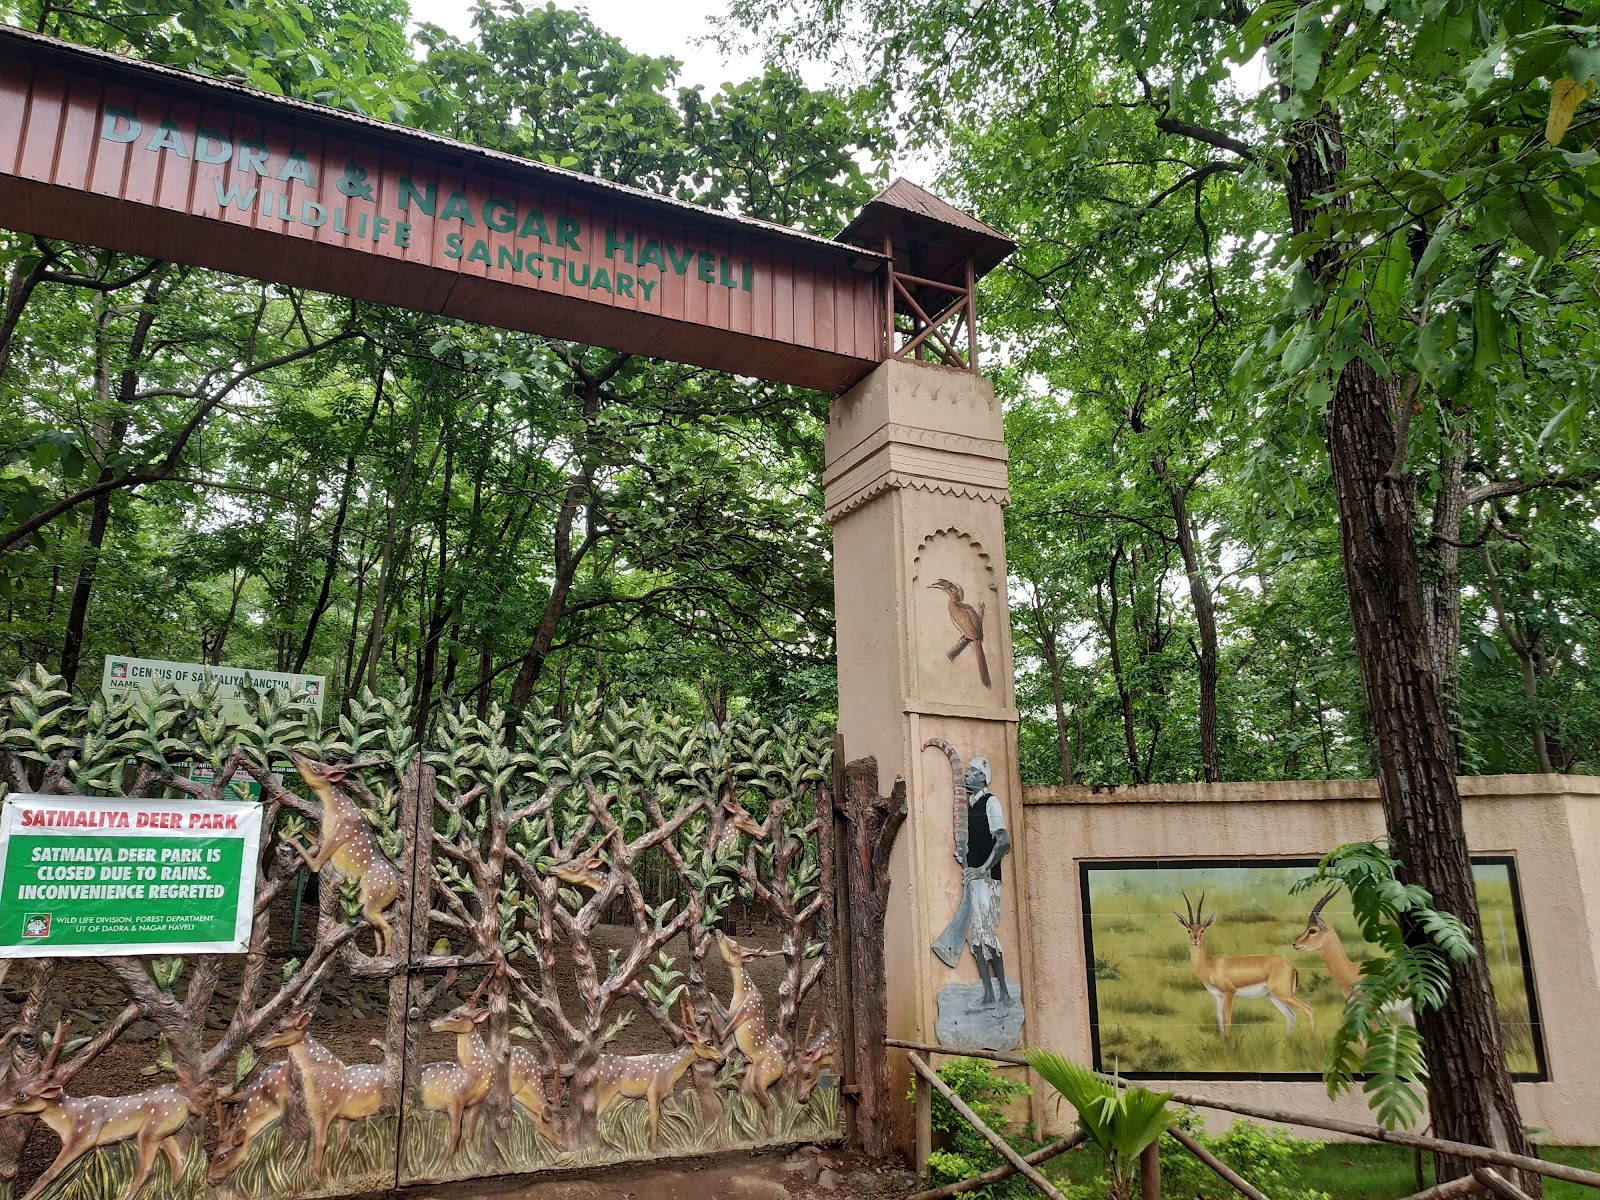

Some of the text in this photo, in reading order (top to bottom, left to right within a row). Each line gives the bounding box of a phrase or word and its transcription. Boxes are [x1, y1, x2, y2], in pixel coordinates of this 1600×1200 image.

[101, 105, 752, 293] DADRA & NAGAR HAVELI
[213, 177, 658, 302] WILDLIFE SANCTUARY
[131, 666, 172, 680] CENUS
[175, 670, 189, 681] OF
[110, 679, 140, 689] NAME
[21, 809, 238, 830] SATMALIYA DEER PARK
[31, 847, 221, 863] SATMALYA DEER PARK IS
[37, 866, 212, 881] CLOSED DUE TO RAINS.
[18, 884, 225, 900] INCONVENIENCE REGRETED
[56, 916, 77, 924] WILD
[96, 916, 133, 924] DIVISION,
[135, 915, 164, 923] FOREST
[131, 924, 137, 932] &
